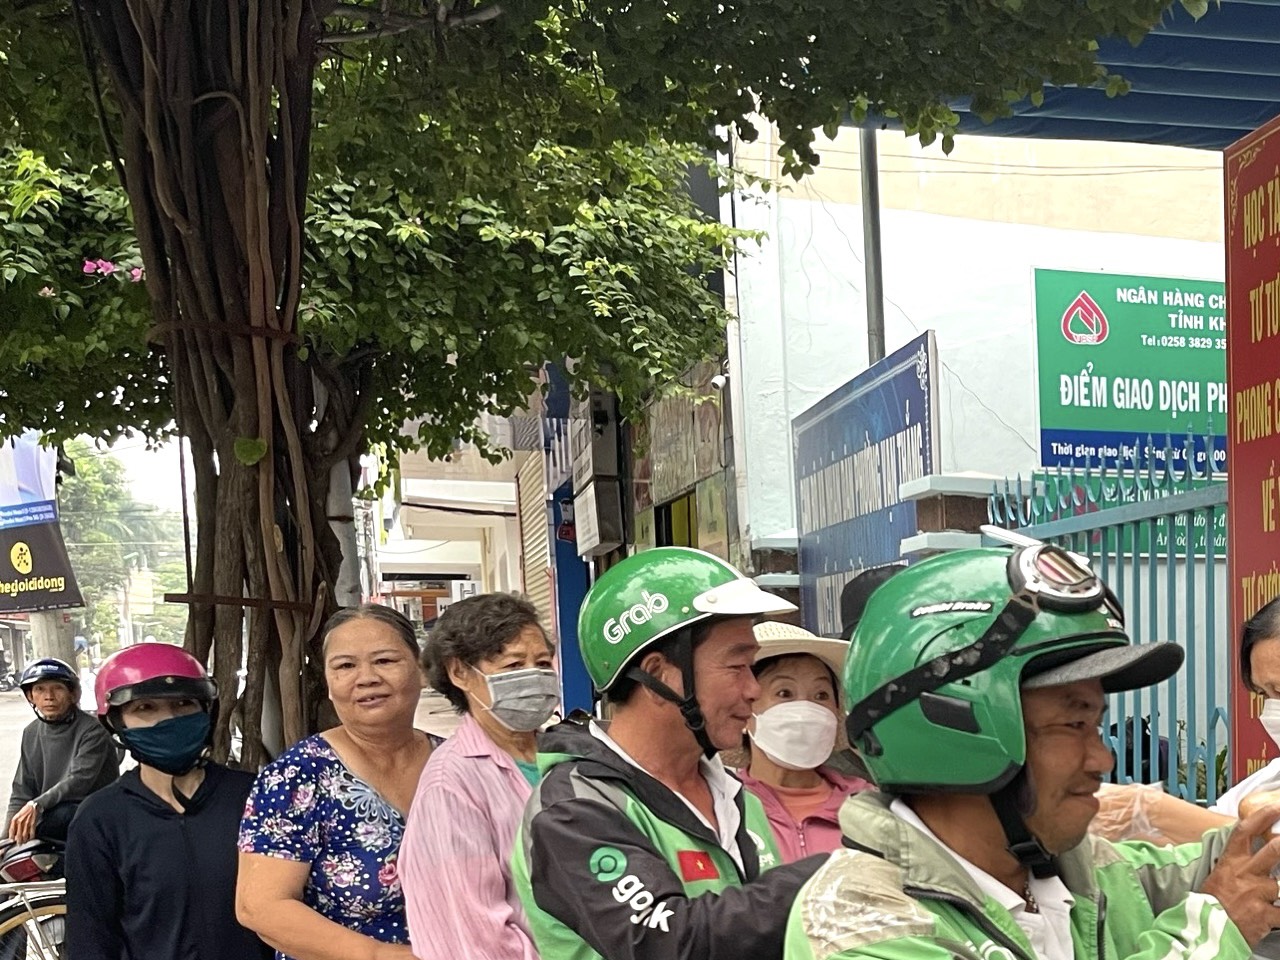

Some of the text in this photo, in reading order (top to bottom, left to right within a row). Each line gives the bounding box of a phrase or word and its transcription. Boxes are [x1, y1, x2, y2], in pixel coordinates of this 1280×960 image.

[1243, 184, 1265, 258] HỌC
[1116, 286, 1158, 305] NGÂN
[1162, 288, 1205, 308] HÀNG
[1168, 309, 1204, 330] TỈNH
[1249, 280, 1264, 344] TƯ
[1188, 337, 1213, 349] 3829
[1060, 361, 1108, 408] ĐIỂM
[1113, 377, 1154, 411] GIAO
[1159, 380, 1201, 419] DỊCH
[1236, 380, 1272, 446] PHONG
[1261, 458, 1277, 533] VỀ
[603, 589, 669, 644] Grab
